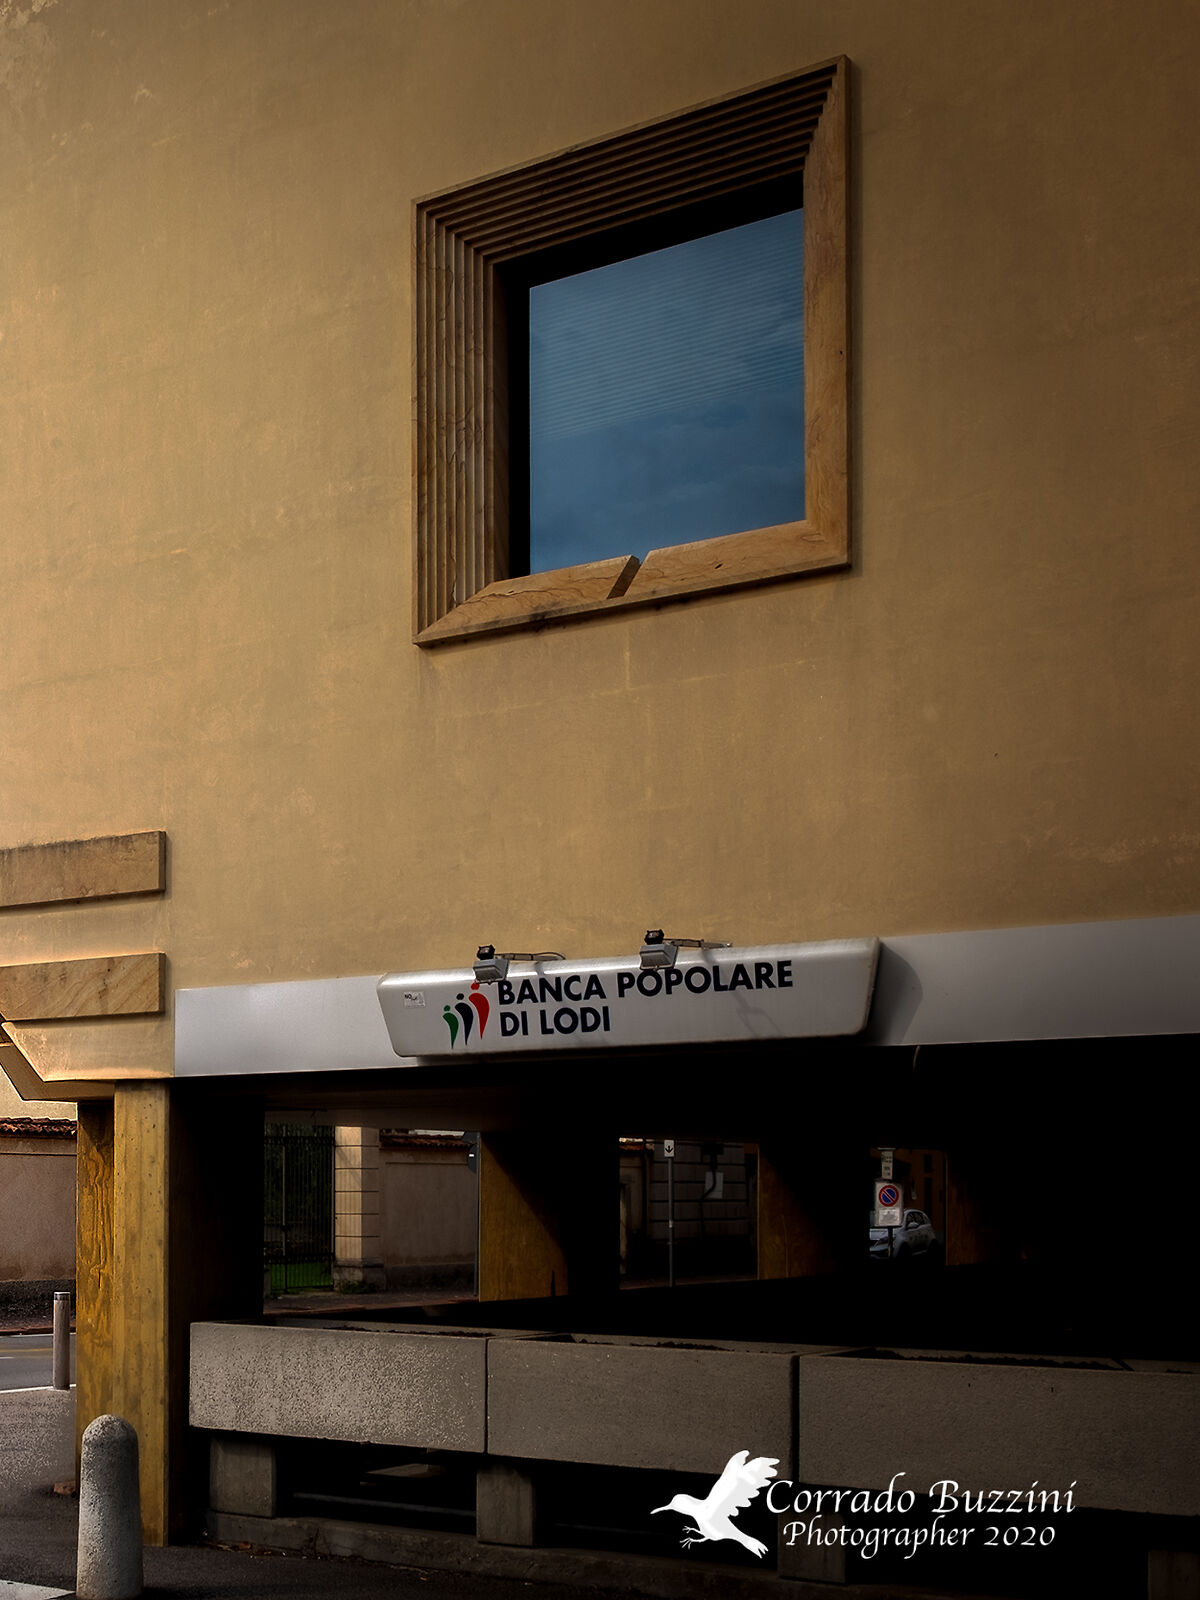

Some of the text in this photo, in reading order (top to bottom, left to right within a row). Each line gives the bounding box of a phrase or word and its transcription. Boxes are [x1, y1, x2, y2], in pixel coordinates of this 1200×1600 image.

[498, 961, 793, 1005] BANCA POPOLARE
[501, 1006, 609, 1036] DI LODI
